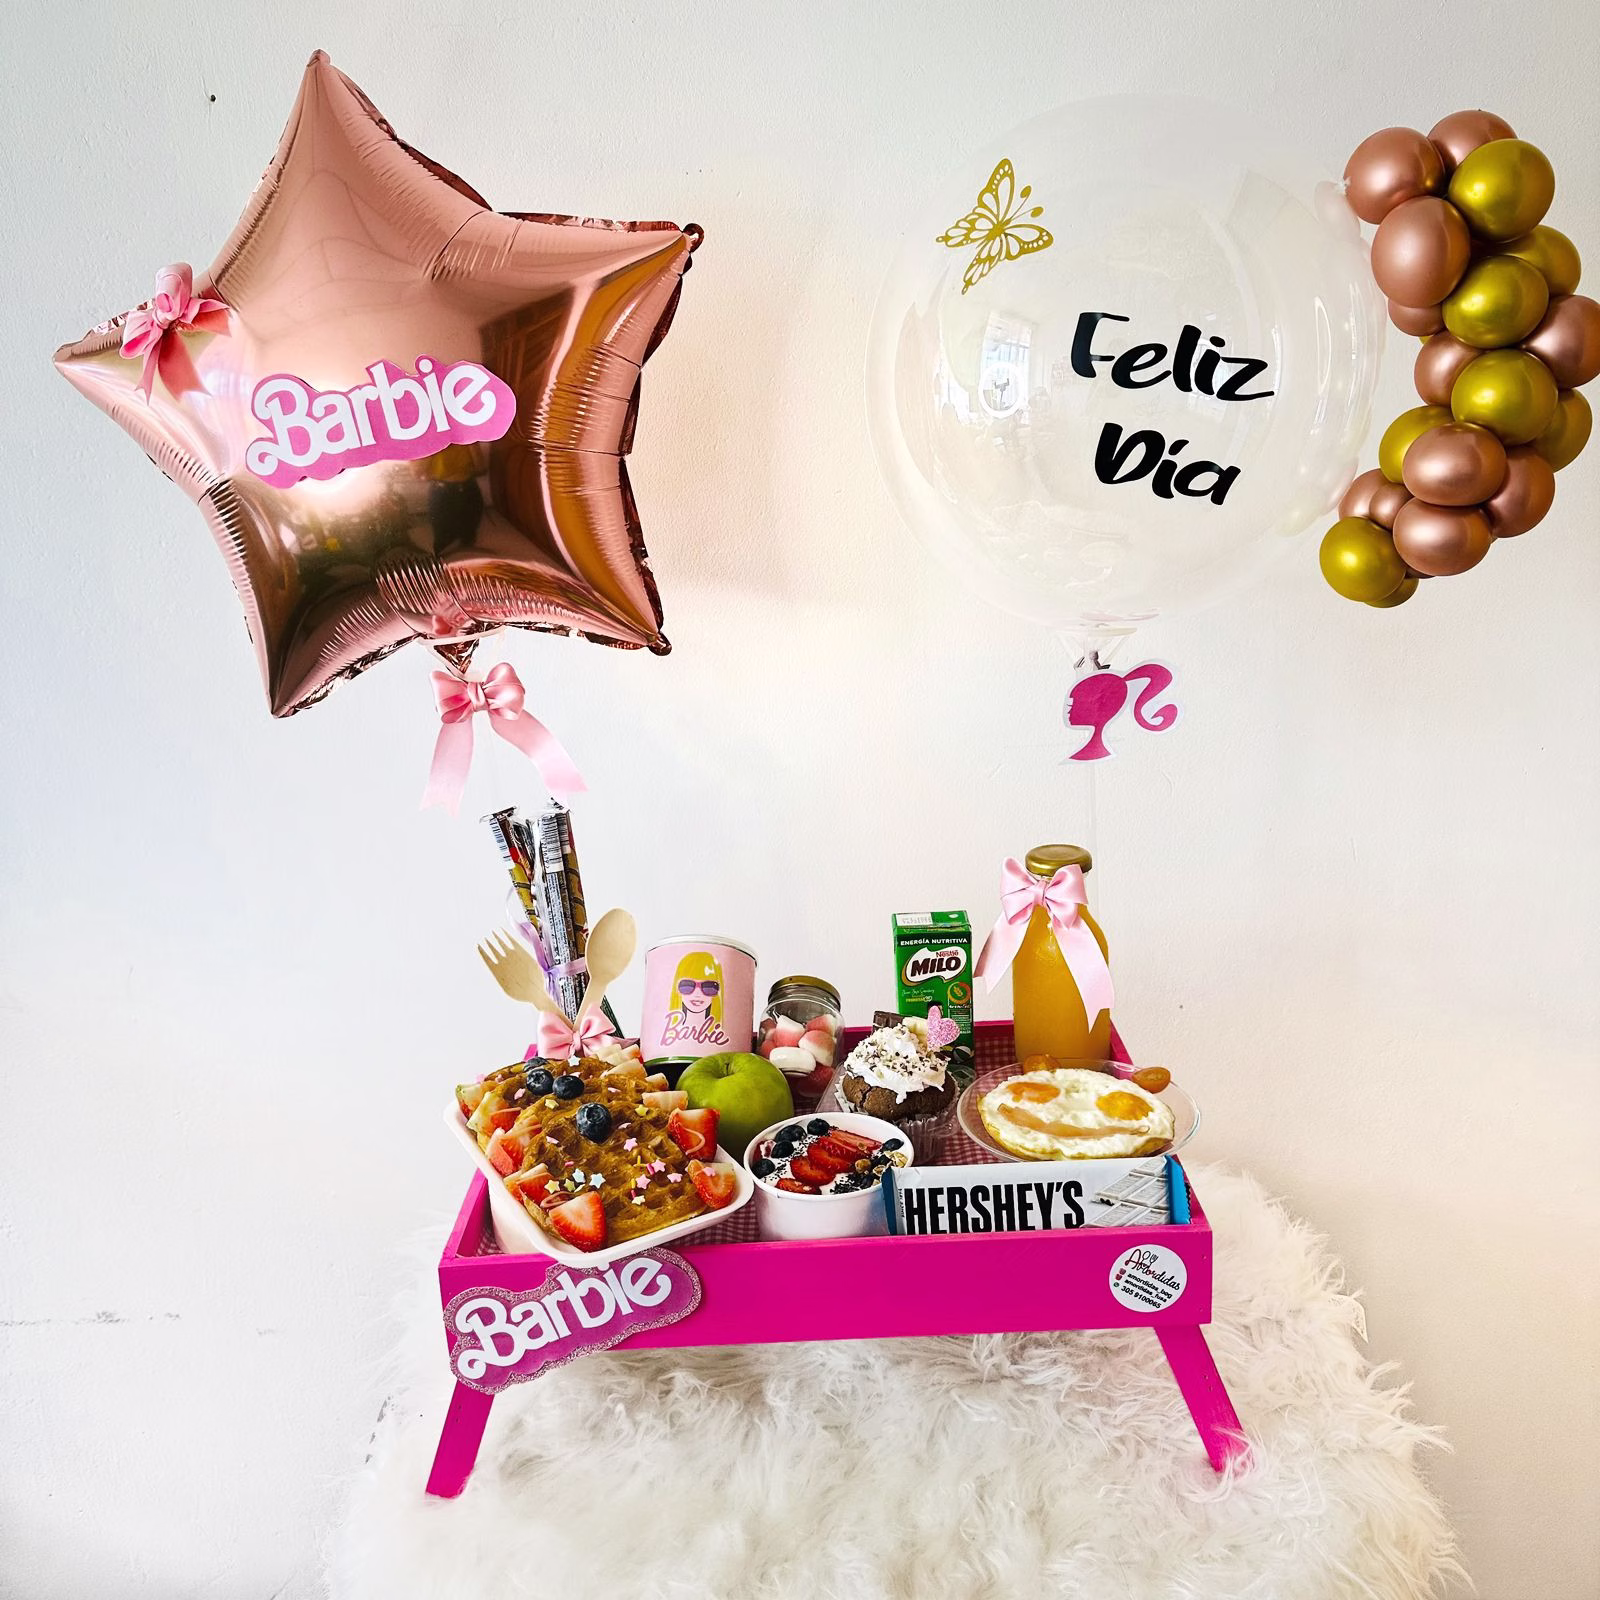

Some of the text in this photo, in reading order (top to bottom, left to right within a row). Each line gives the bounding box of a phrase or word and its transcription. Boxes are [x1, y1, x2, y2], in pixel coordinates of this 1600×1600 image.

[1071, 312, 1275, 401] Feliz
[246, 358, 497, 477] Barbie
[1095, 422, 1242, 506] Día
[900, 938, 930, 946] ENERGÍA
[910, 956, 961, 977] MILO
[660, 1011, 730, 1046] Barbie
[904, 1180, 1085, 1235] HERSHEY'S
[1121, 1285, 1135, 1296] 305
[455, 1257, 672, 1380] Barbie
